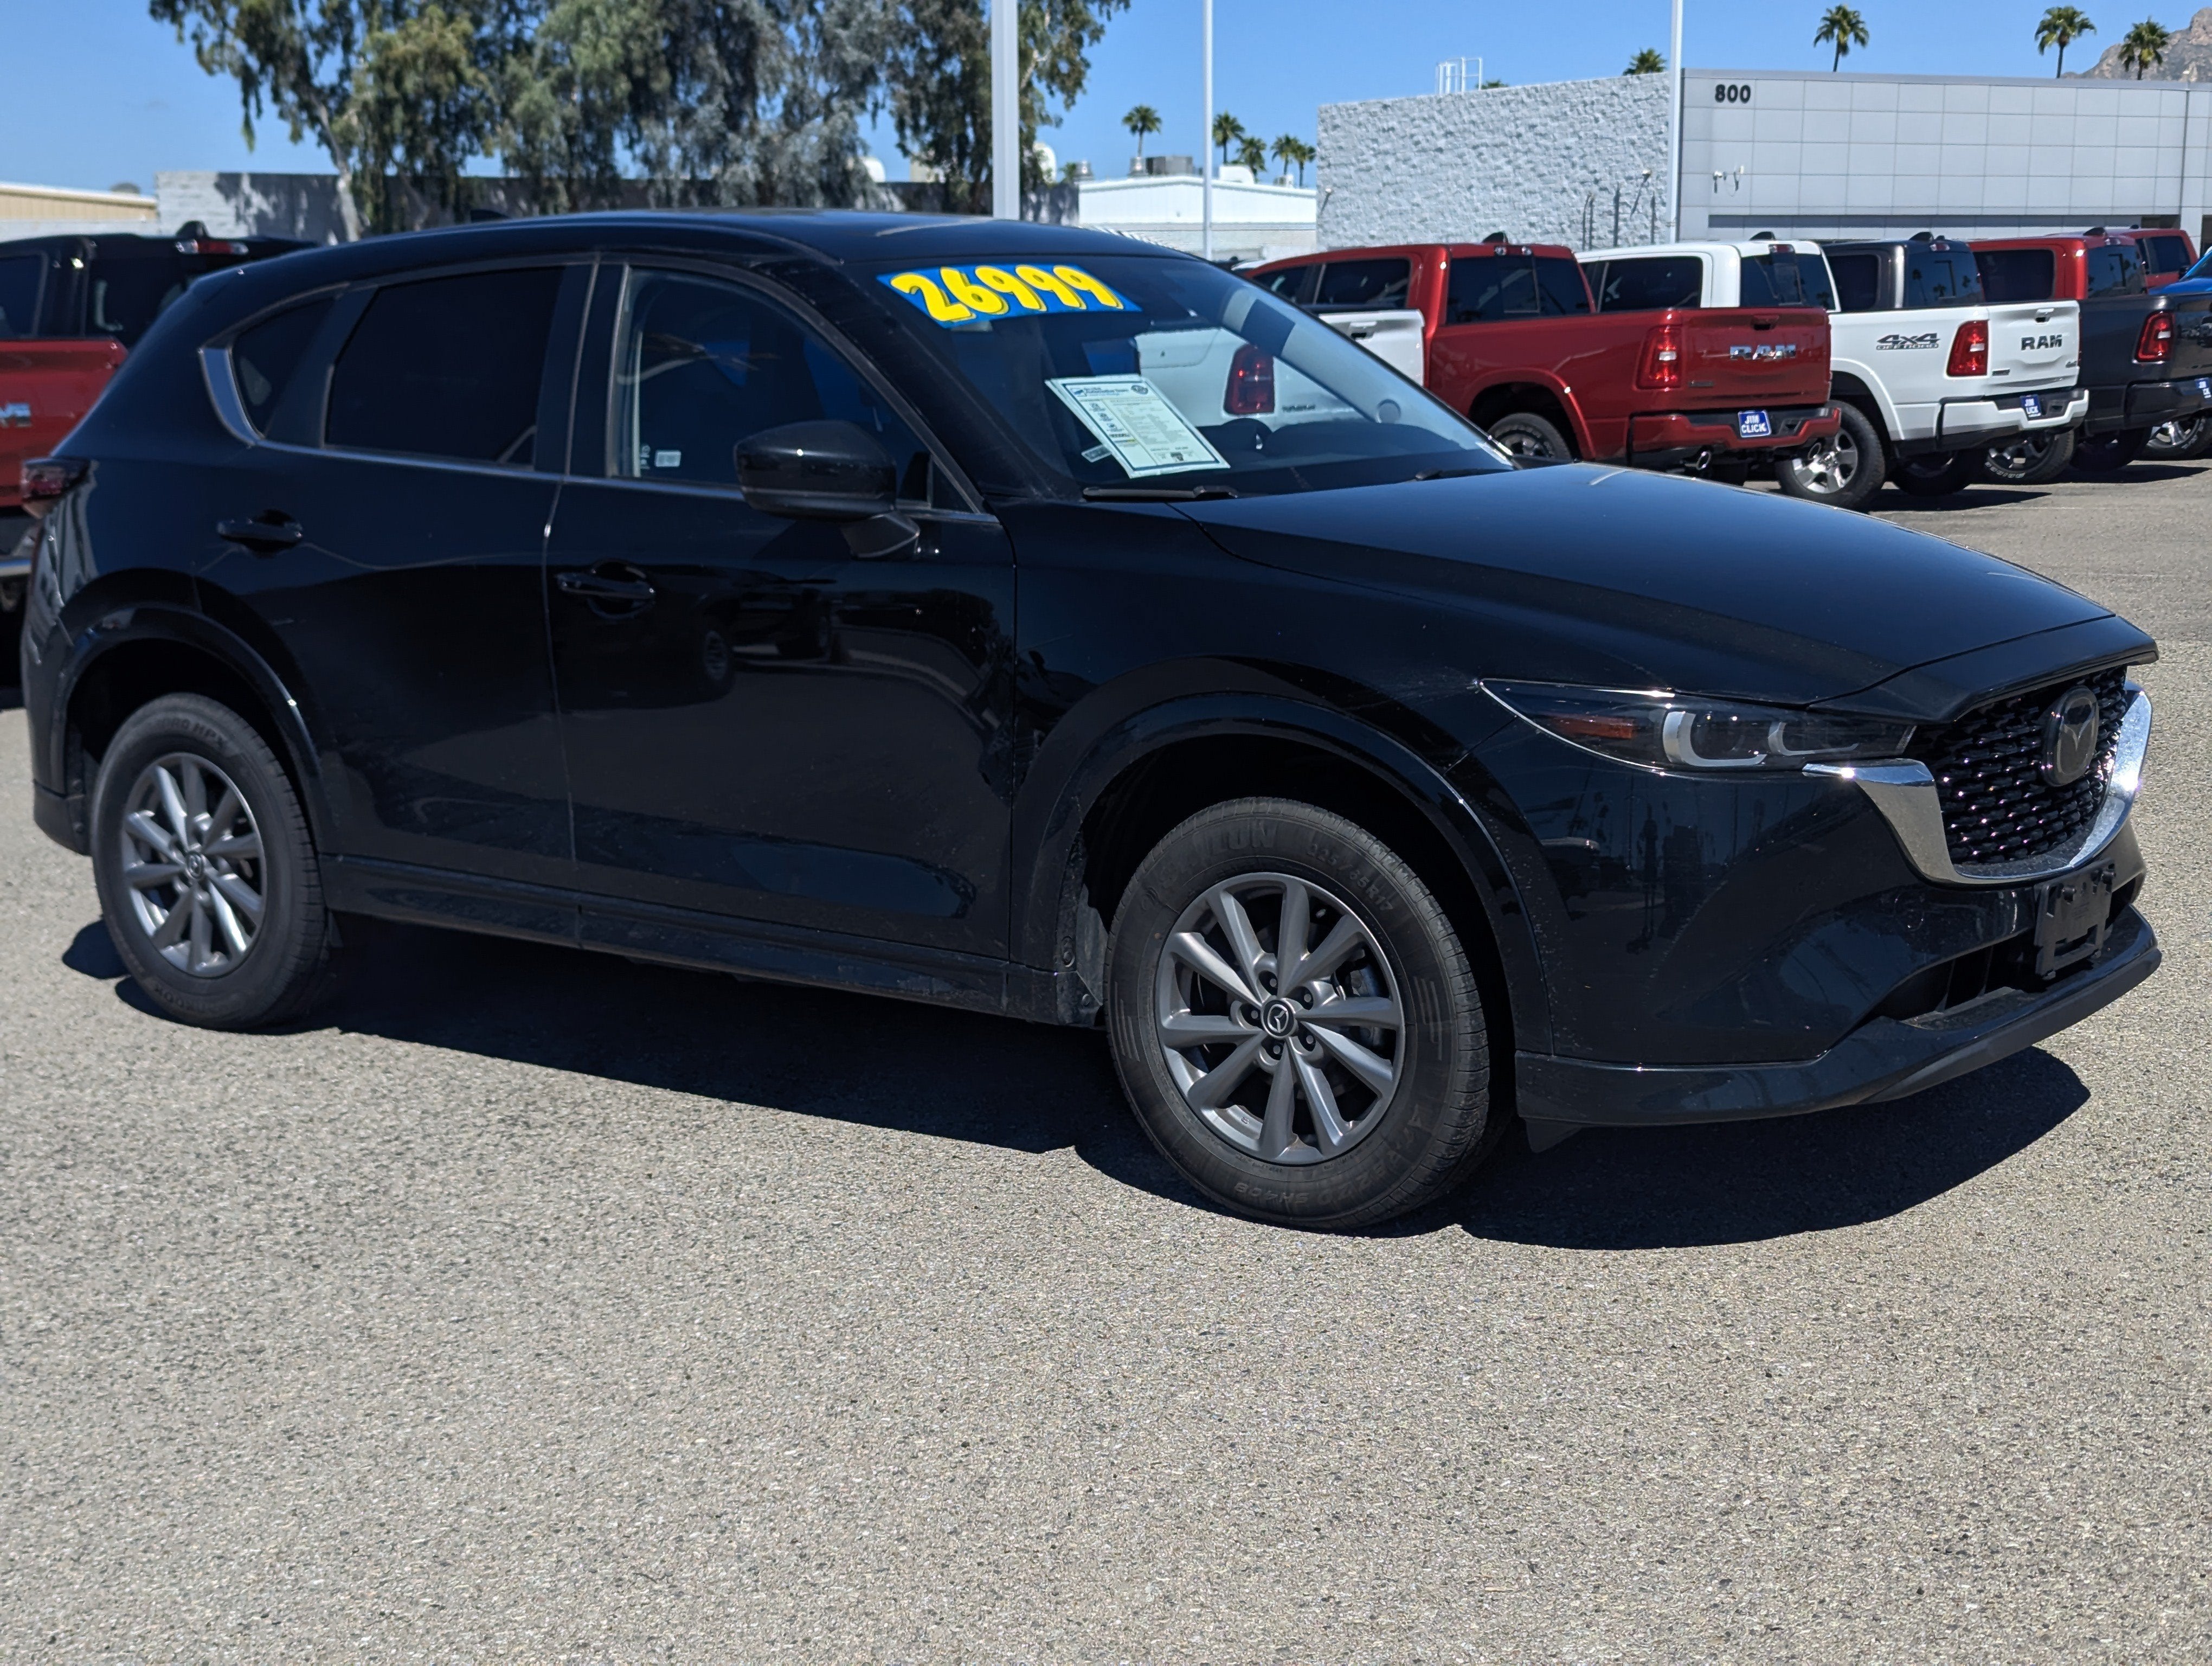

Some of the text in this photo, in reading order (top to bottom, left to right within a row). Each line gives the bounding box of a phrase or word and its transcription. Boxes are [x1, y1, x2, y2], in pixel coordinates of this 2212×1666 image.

[1715, 84, 1751, 104] 800
[890, 265, 1124, 322] 26999
[1877, 332, 1940, 345] 4x4
[2021, 334, 2062, 350] RAM
[1729, 344, 1796, 362] RAM
[1744, 414, 1760, 425] JIM
[1741, 423, 1766, 433] CLICK
